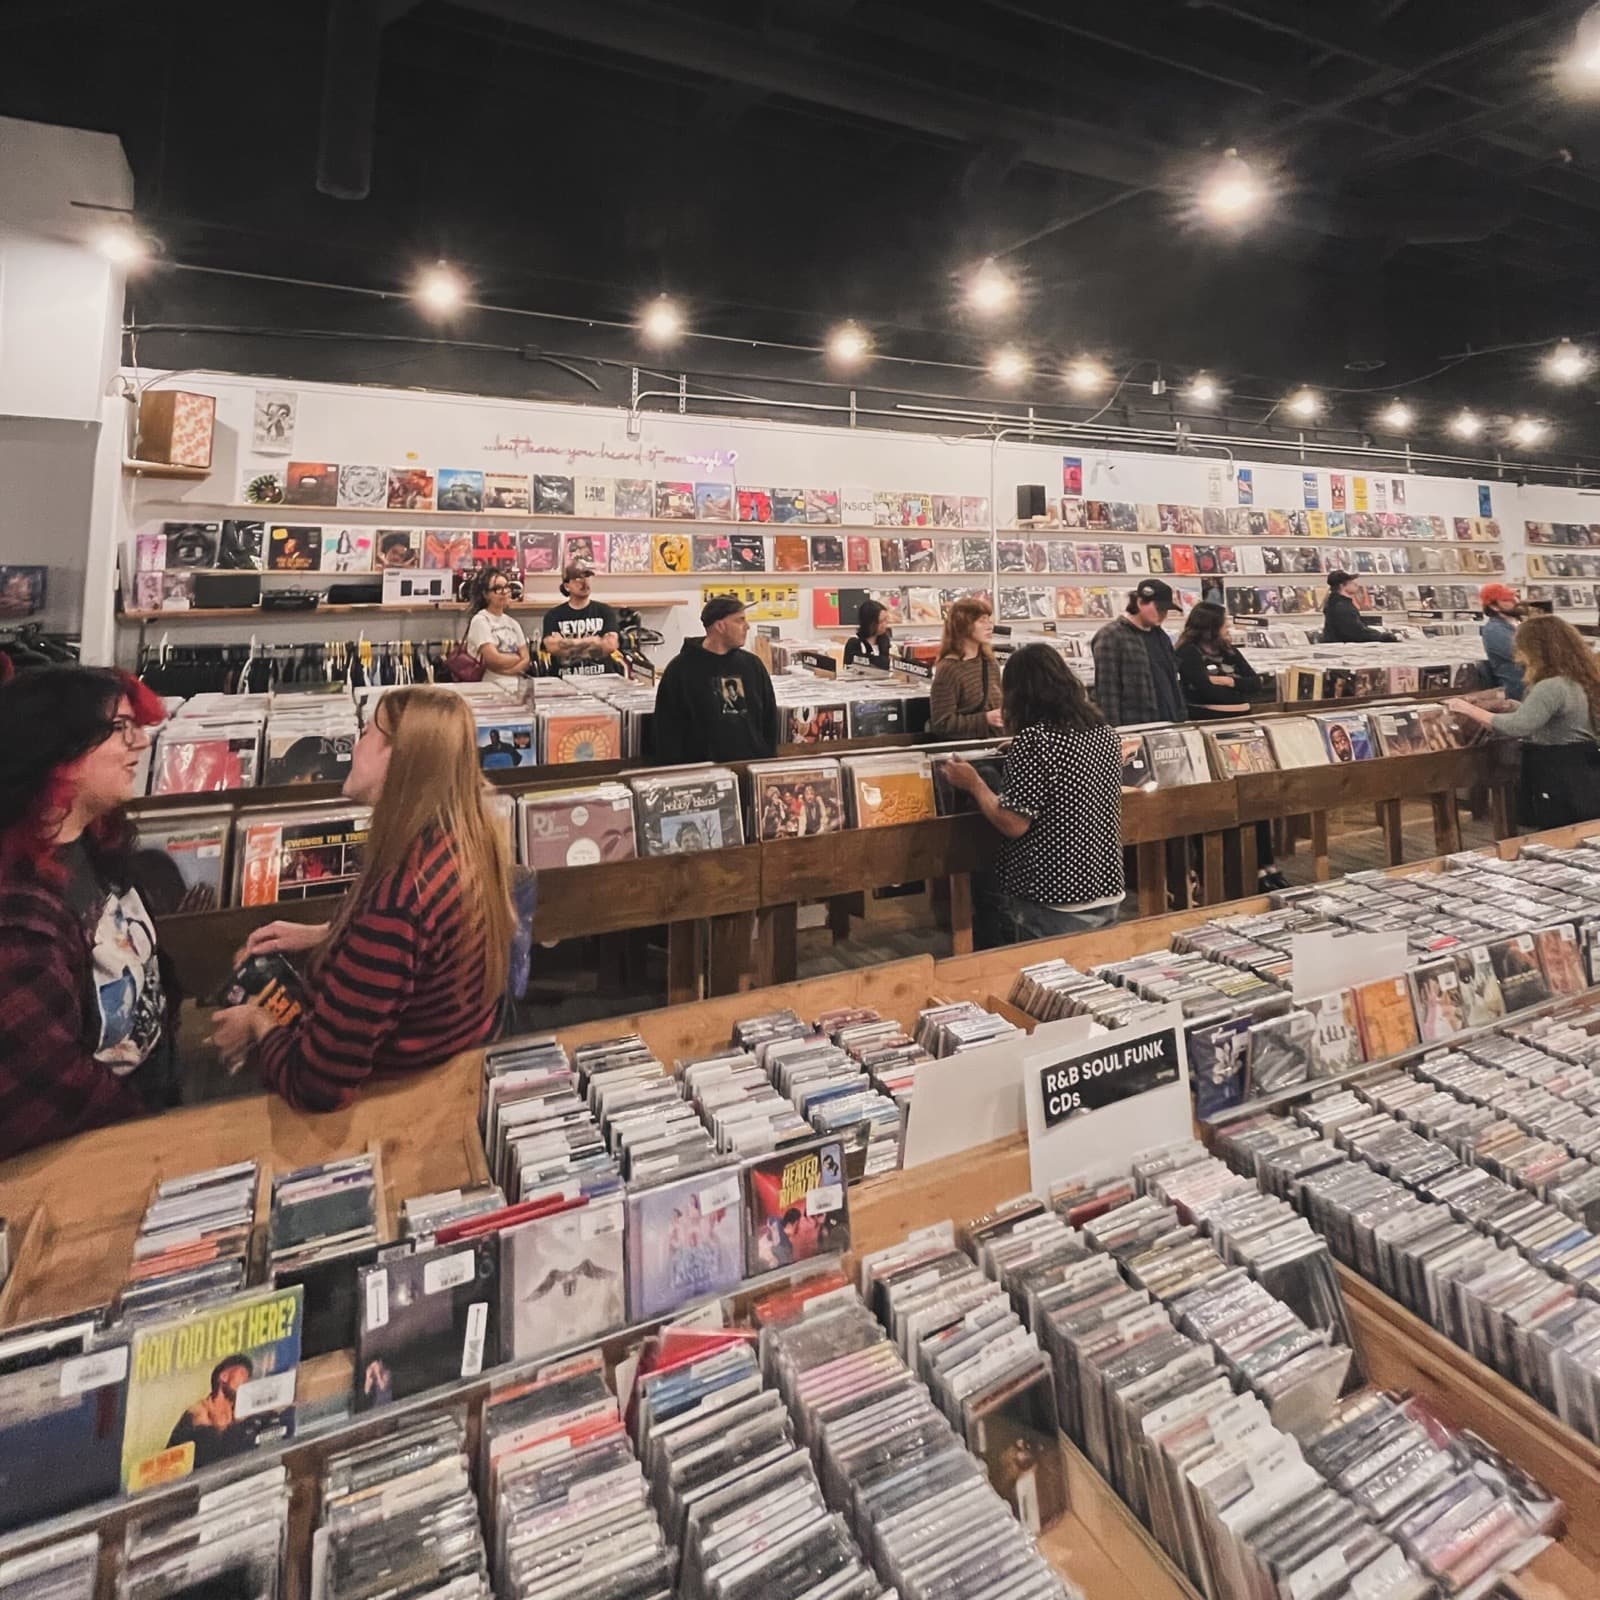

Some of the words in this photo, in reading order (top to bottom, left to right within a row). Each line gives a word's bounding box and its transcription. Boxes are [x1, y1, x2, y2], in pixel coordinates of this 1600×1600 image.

[566, 448, 597, 464] you
[842, 502, 872, 512] INSIDE
[894, 659, 929, 677] ELECTRONIC
[1046, 1066, 1080, 1093] R&B
[1081, 1053, 1122, 1080] SOUL
[1124, 1039, 1164, 1067] FUNK
[1049, 1092, 1081, 1115] CDs
[783, 1154, 818, 1188] HEATED
[135, 1332, 175, 1382] HOW
[176, 1322, 205, 1369] DID
[207, 1319, 214, 1360] I
[216, 1312, 246, 1357] GET
[247, 1296, 297, 1348] HERE?
